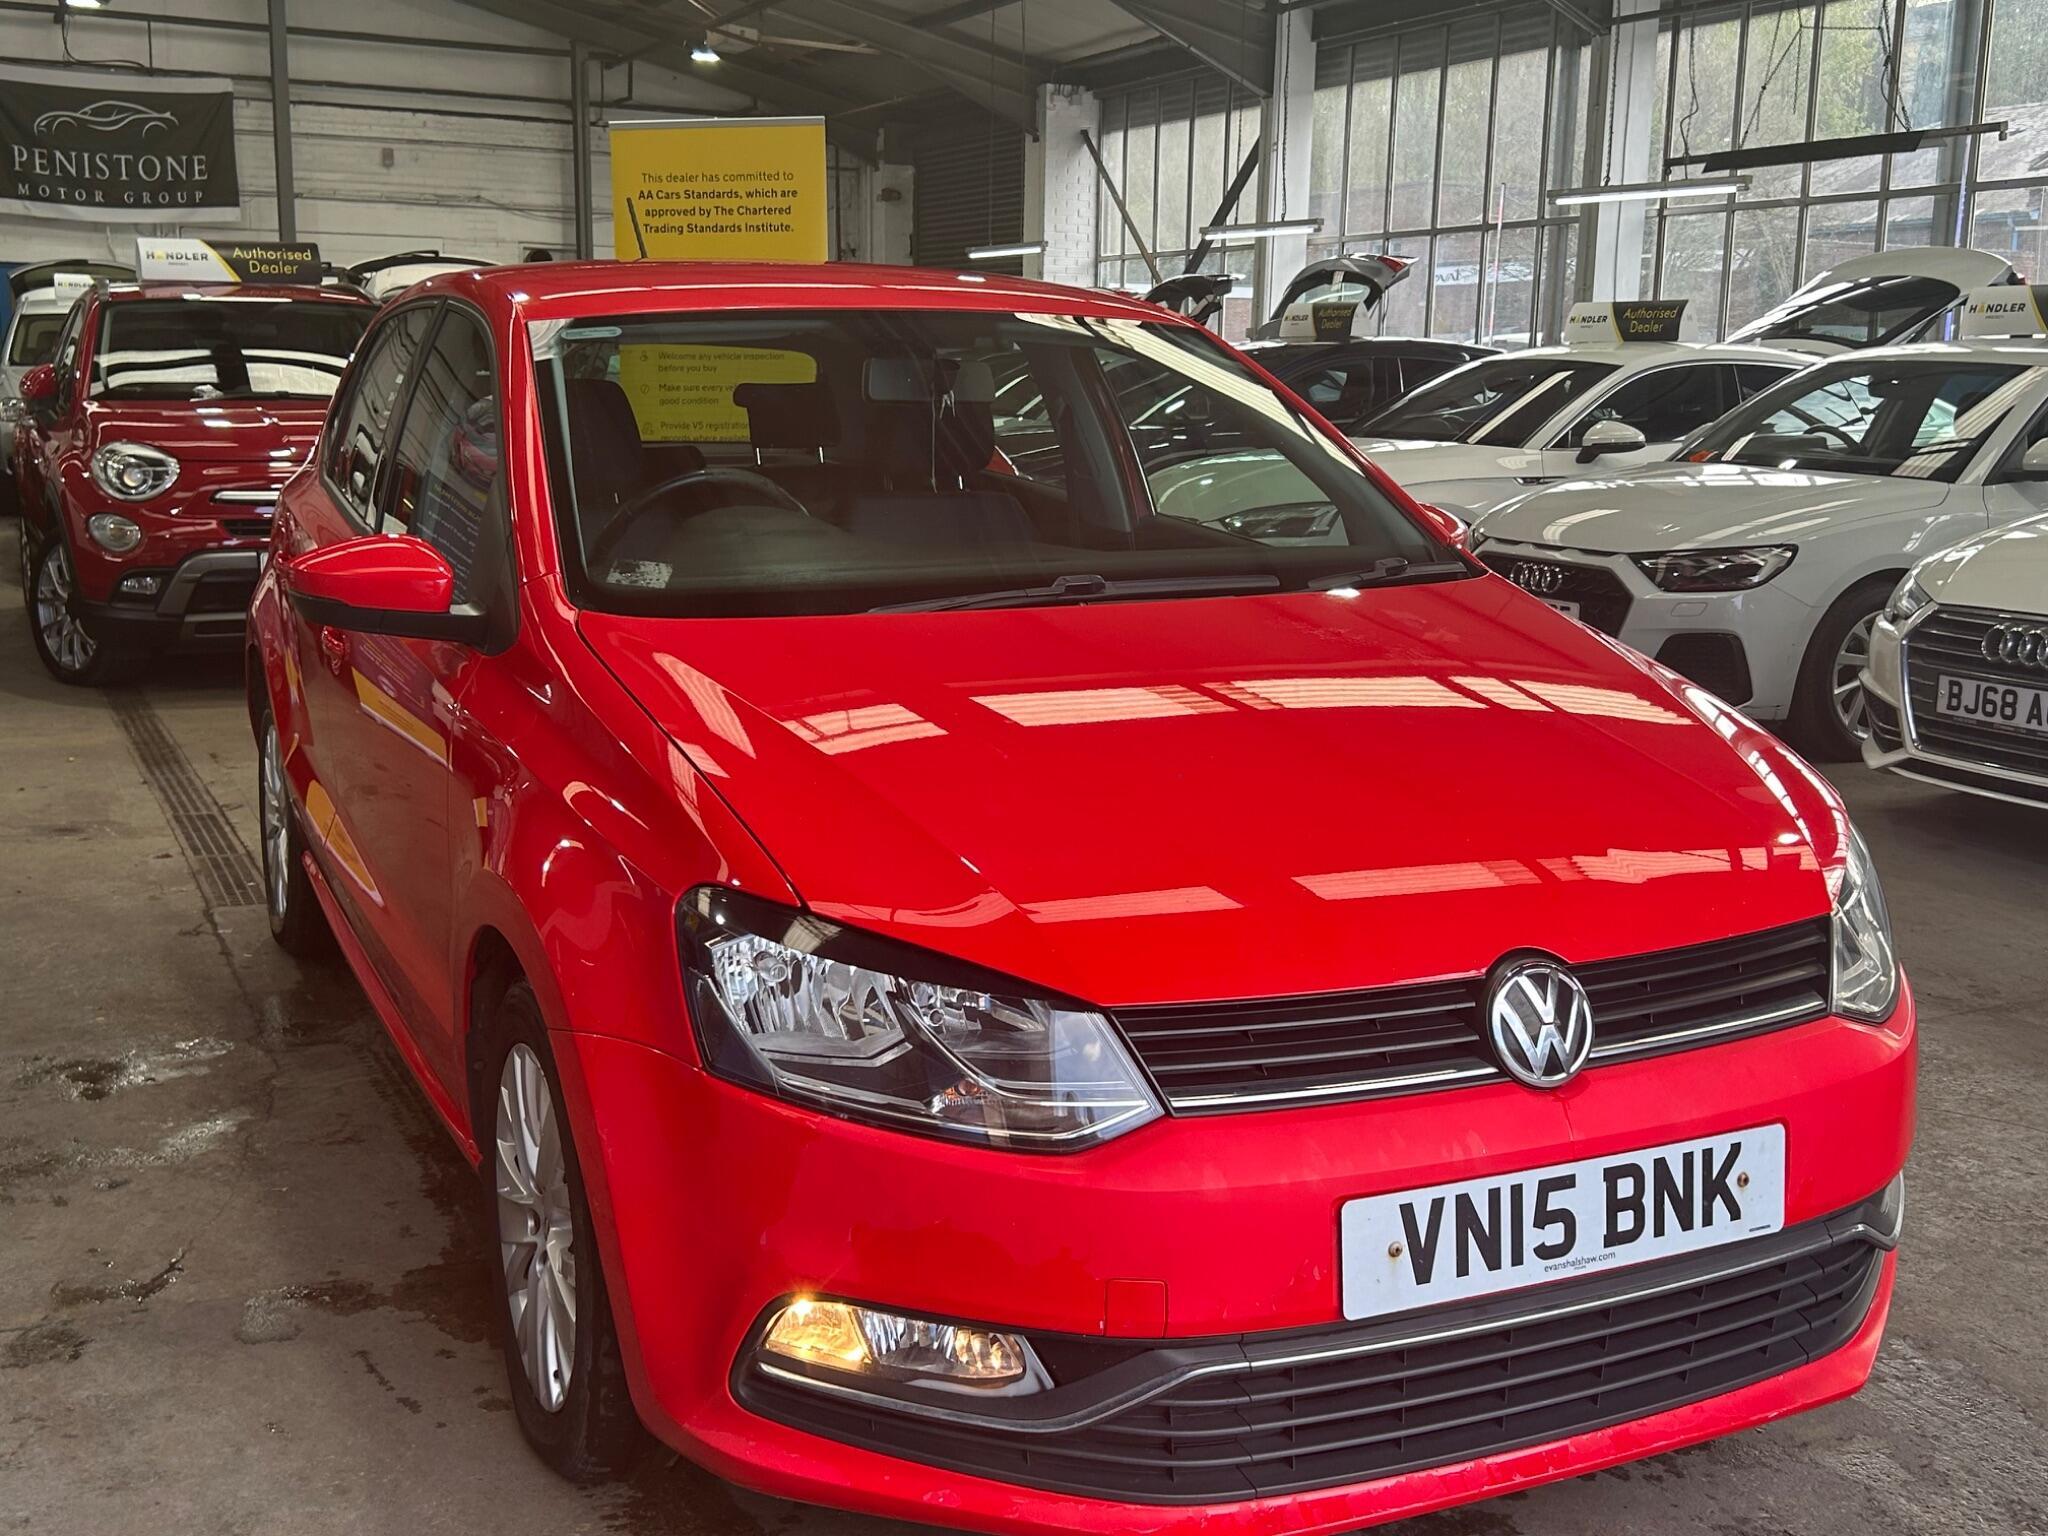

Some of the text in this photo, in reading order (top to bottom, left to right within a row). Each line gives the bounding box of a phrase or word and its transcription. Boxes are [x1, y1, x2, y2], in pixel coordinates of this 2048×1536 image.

[12, 144, 208, 181] PENISTONE
[642, 171, 794, 183] This dealer has committed to
[18, 183, 203, 204] MOTOR GROUP
[638, 188, 798, 200] AA Cars Standards, which are
[645, 205, 791, 218] approved by The Chartered
[643, 222, 794, 235] Trading Standards Institute.
[233, 247, 312, 261] Authorised
[250, 260, 298, 274] Dealer
[1622, 305, 1679, 319] Authorised
[1629, 321, 1663, 333] Dealer
[658, 351, 785, 362] Welcome any vehicle inspection
[658, 364, 718, 374] before you buy
[659, 383, 681, 392] Make
[702, 385, 723, 394] every
[659, 396, 719, 407] good condition
[660, 421, 690, 430] Provide
[692, 421, 704, 429] V5
[1946, 680, 2018, 721] BJ68
[2026, 692, 2048, 727] A
[1399, 1142, 1743, 1286] VN15 BNK
[1544, 1251, 1616, 1273] evanshalshaw.com
